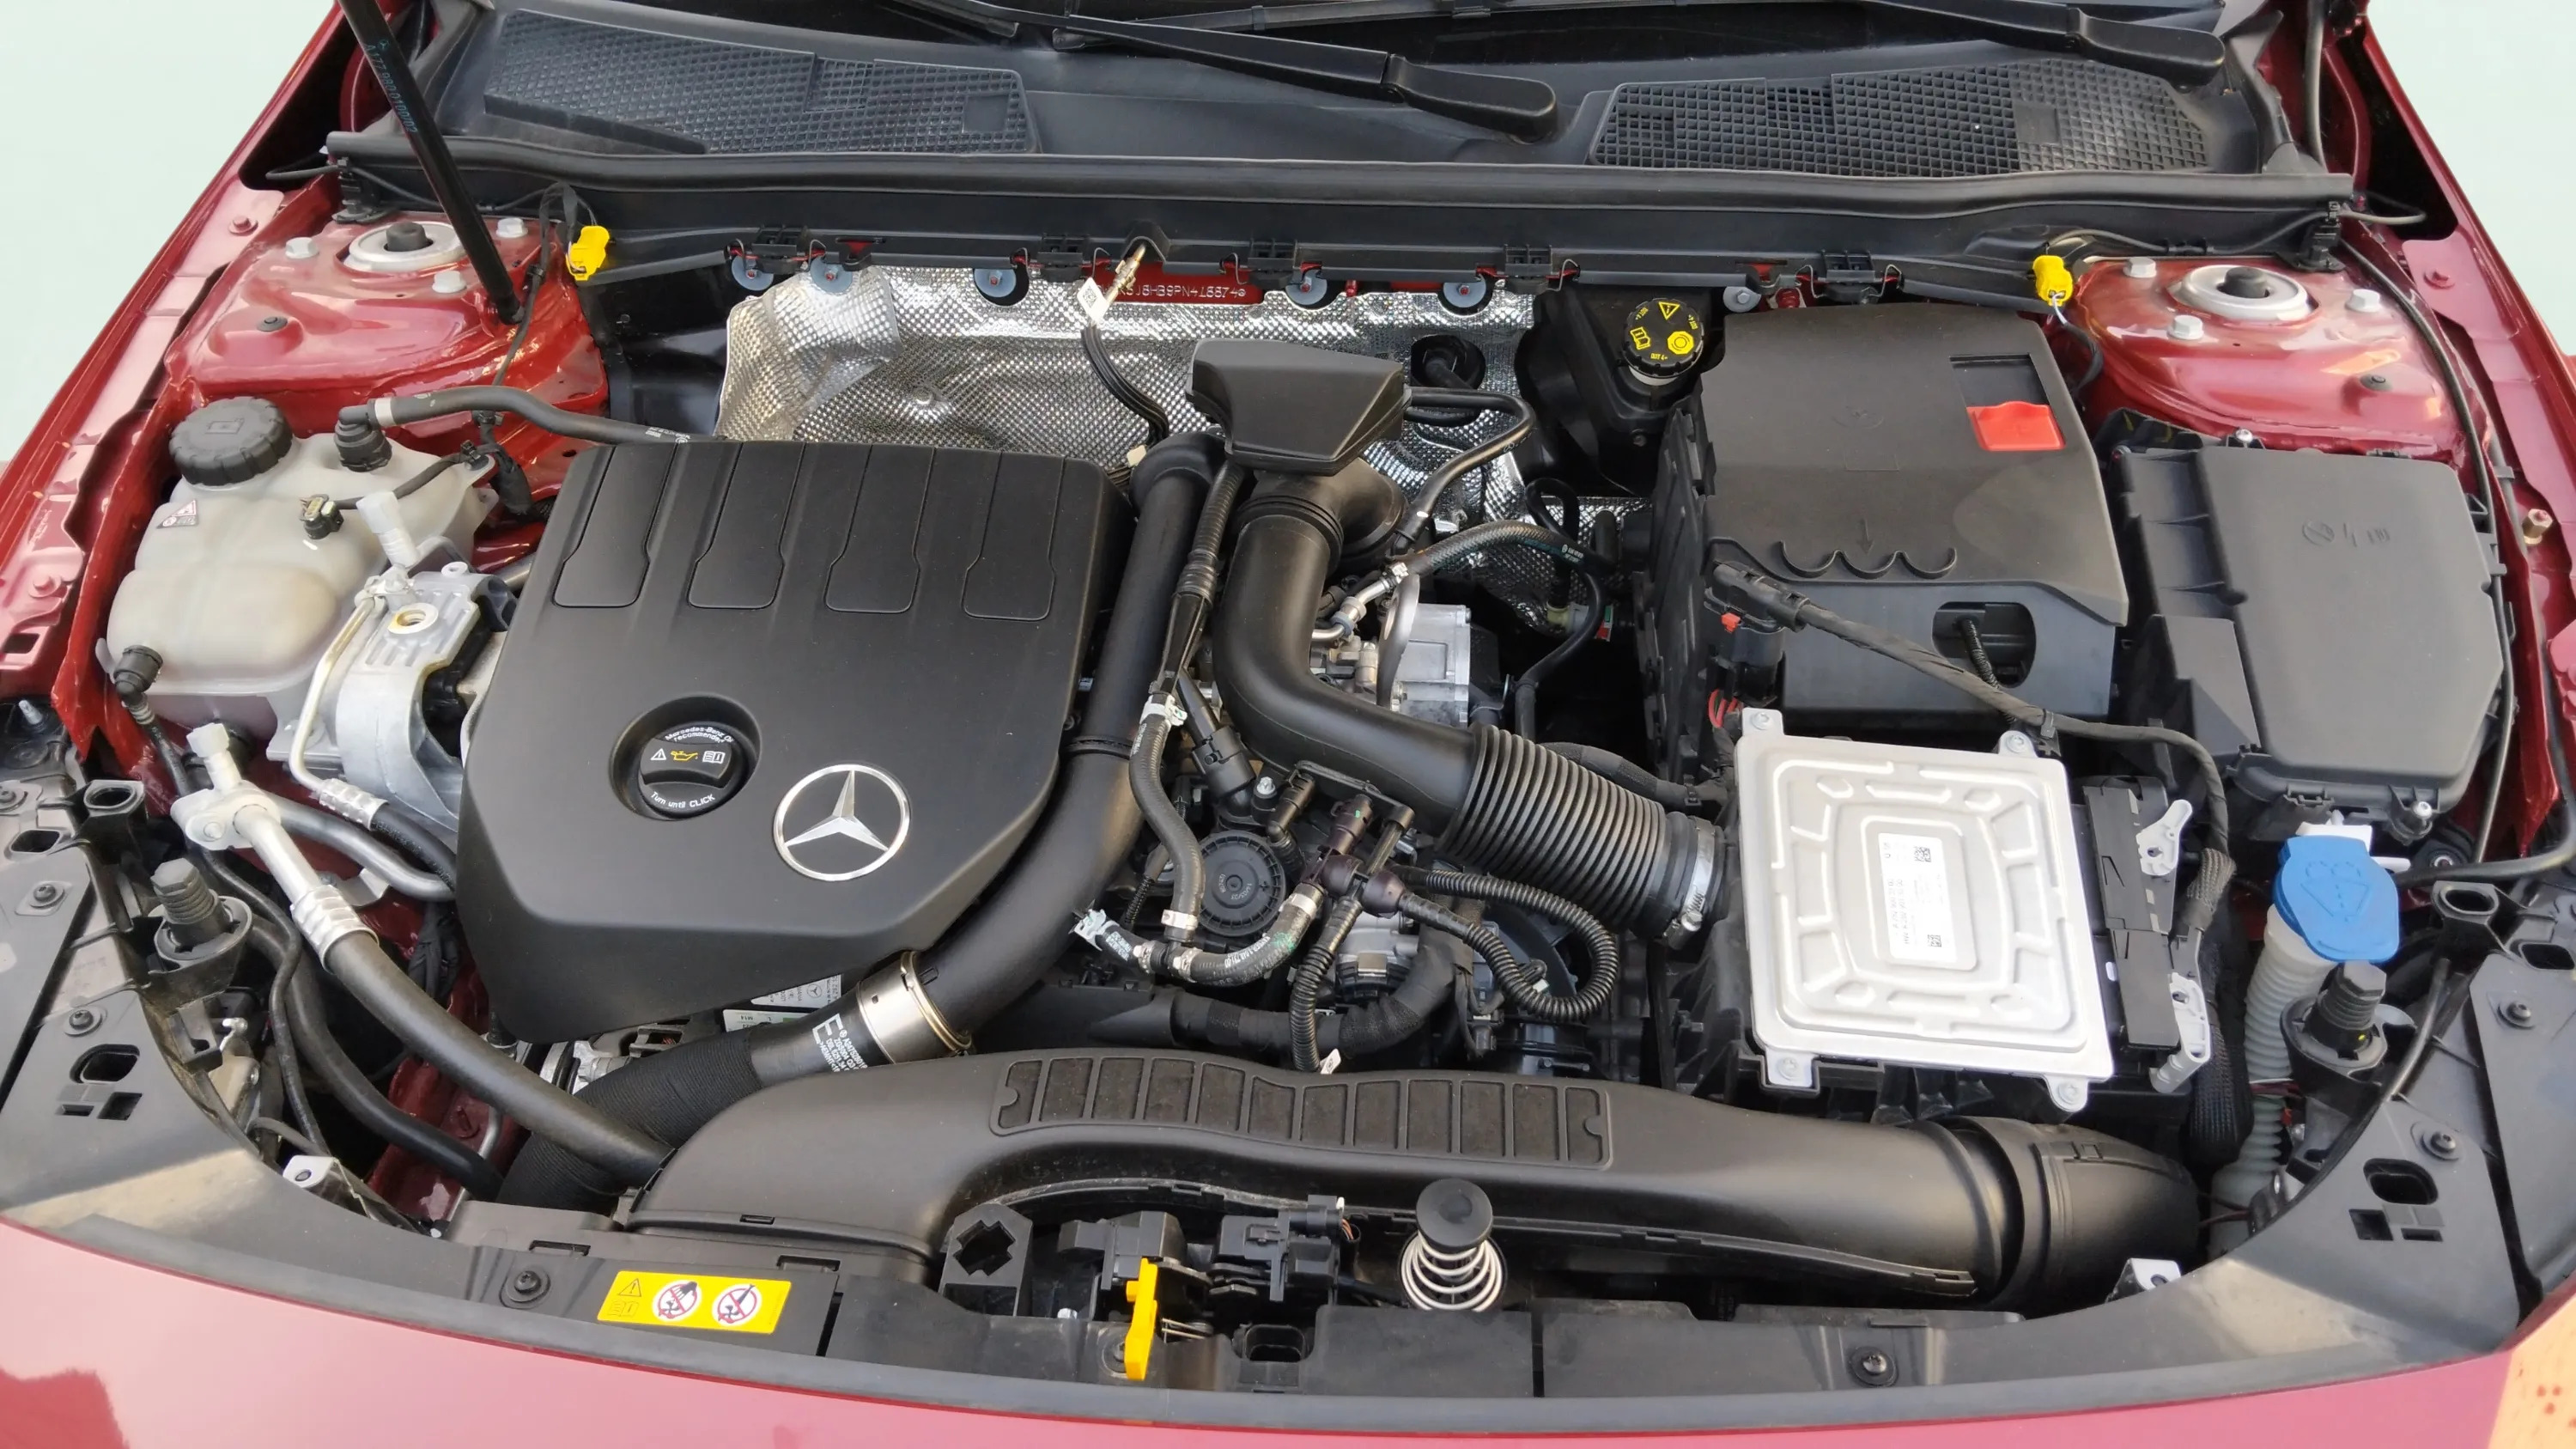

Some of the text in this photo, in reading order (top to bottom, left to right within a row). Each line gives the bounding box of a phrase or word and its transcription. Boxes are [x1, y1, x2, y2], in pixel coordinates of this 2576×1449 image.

[665, 727, 724, 740] Mercedes-Benz
[651, 791, 715, 809] Turn until CLICK
[812, 1013, 843, 1044] E
